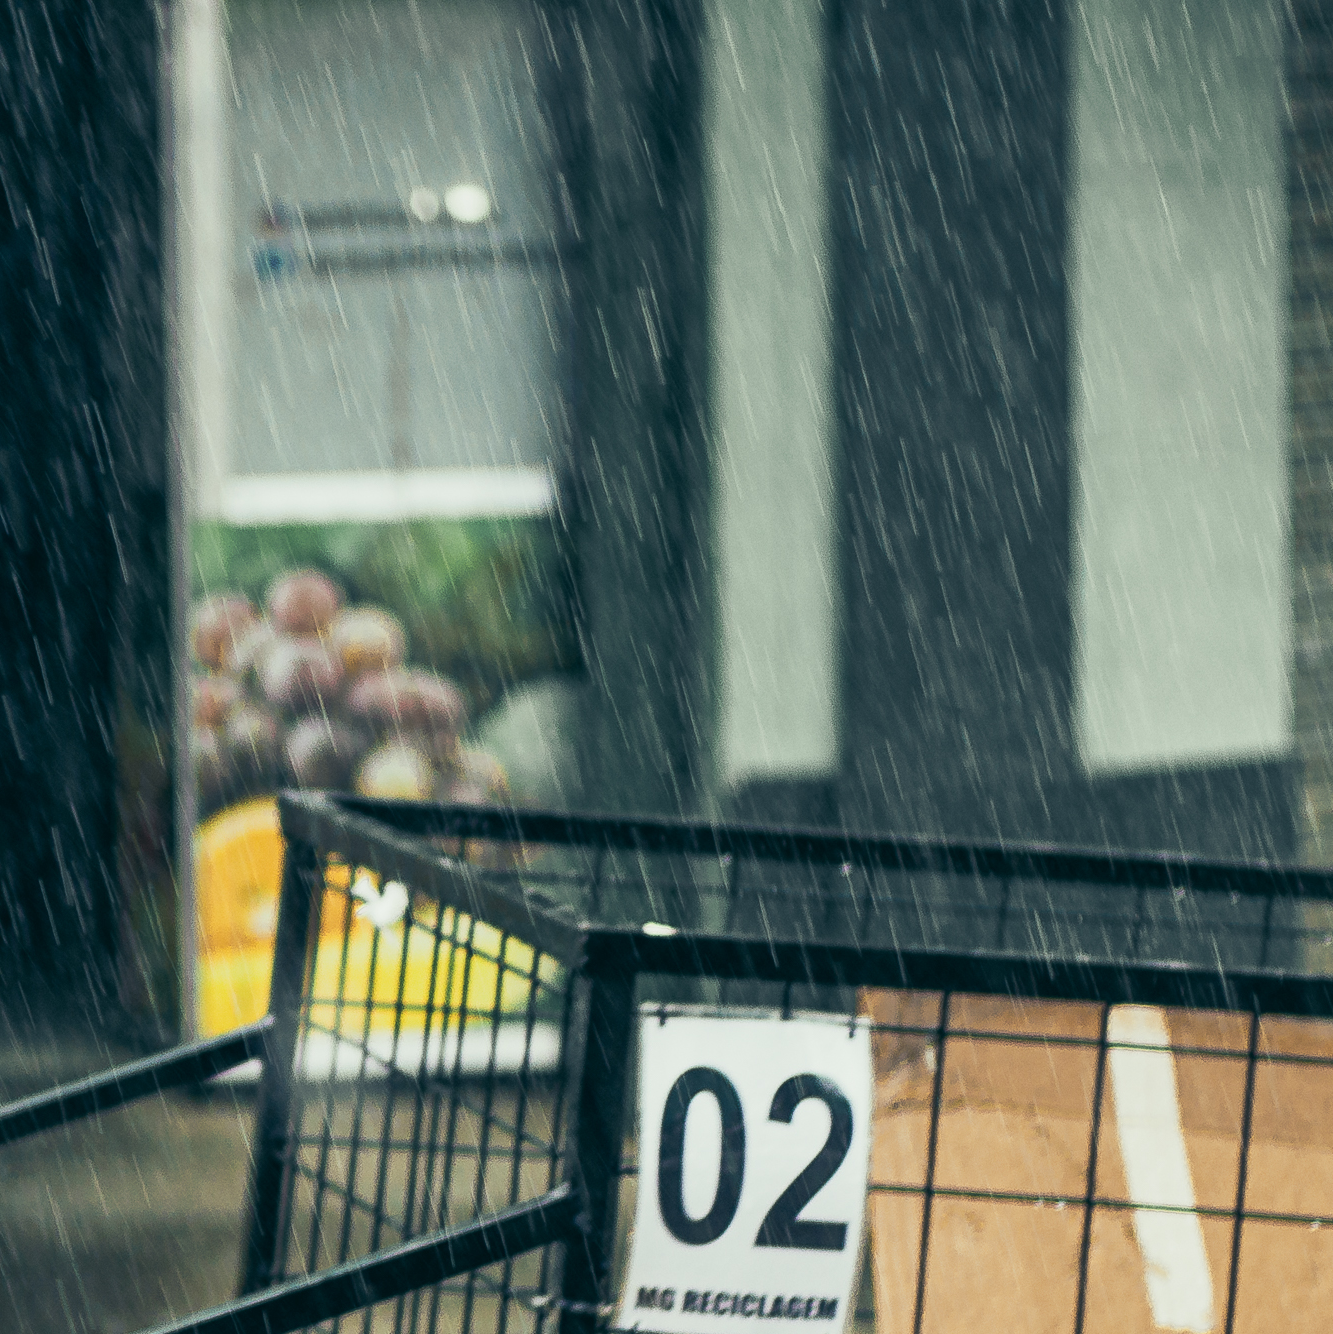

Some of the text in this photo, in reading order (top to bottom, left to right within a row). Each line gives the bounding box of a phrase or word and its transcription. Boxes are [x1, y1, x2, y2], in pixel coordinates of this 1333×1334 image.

[657, 1066, 854, 1251] 02
[635, 1286, 839, 1320] MG RECICLAGEM
